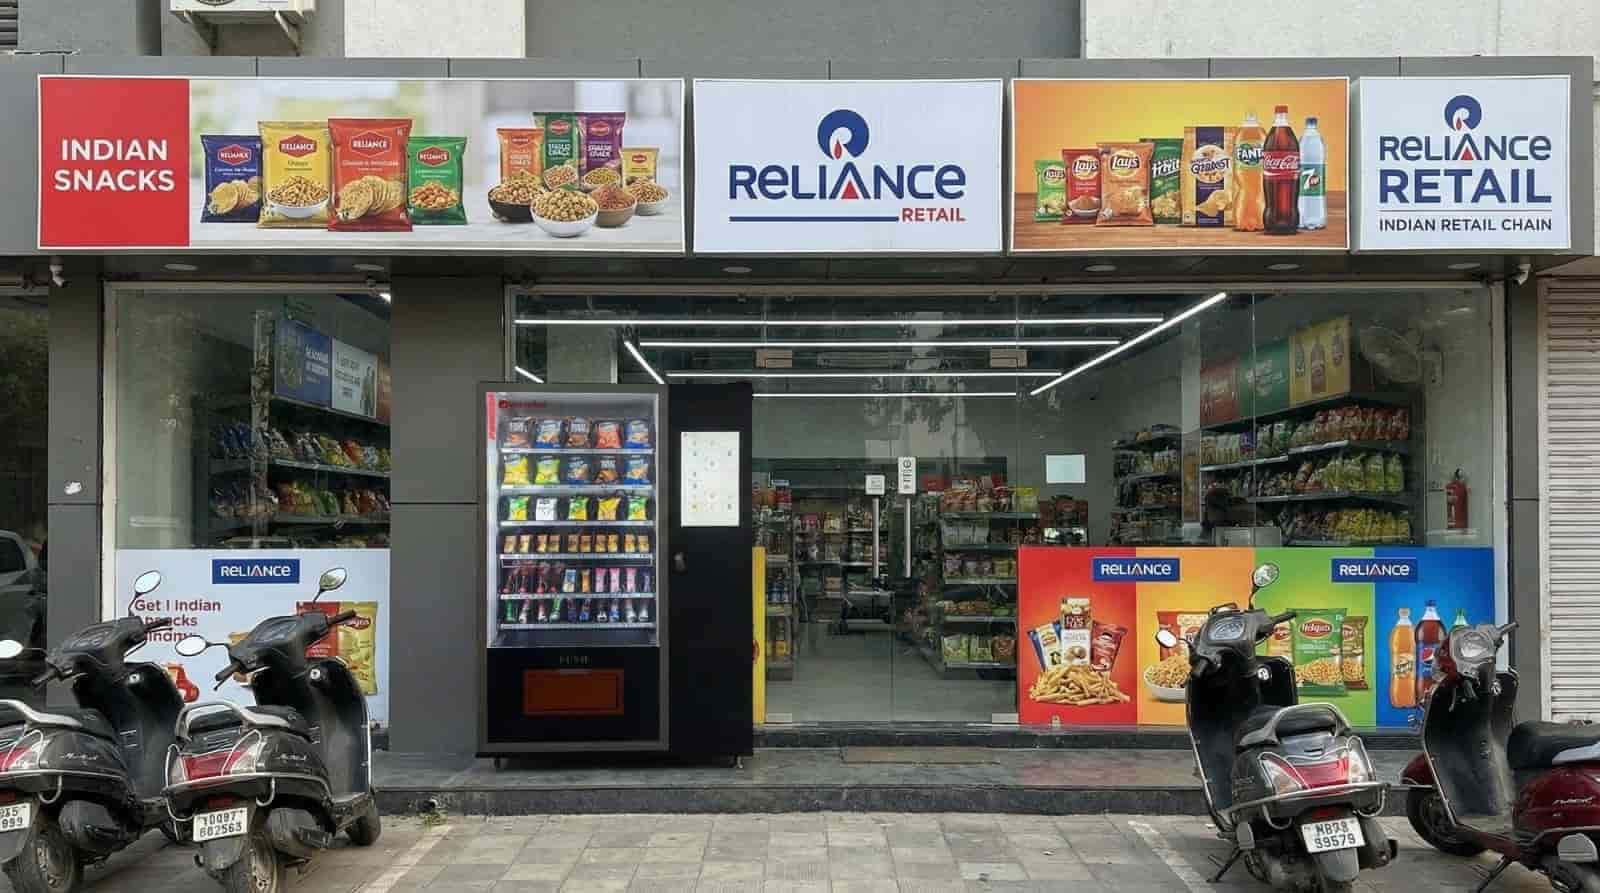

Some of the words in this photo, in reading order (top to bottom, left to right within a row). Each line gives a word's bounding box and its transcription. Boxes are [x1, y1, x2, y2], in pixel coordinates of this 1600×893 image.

[61, 139, 168, 161] INDIAN
[1237, 147, 1264, 160] FANT
[54, 169, 175, 192] SNACKS
[1379, 168, 1552, 204] RETAIL
[901, 207, 966, 222] RETAIL
[1379, 218, 1436, 231] INDIAN
[1441, 218, 1497, 231] RETAIL
[1501, 218, 1552, 231] CHAIN
[134, 599, 160, 612] Get
[175, 599, 221, 612] Indian
